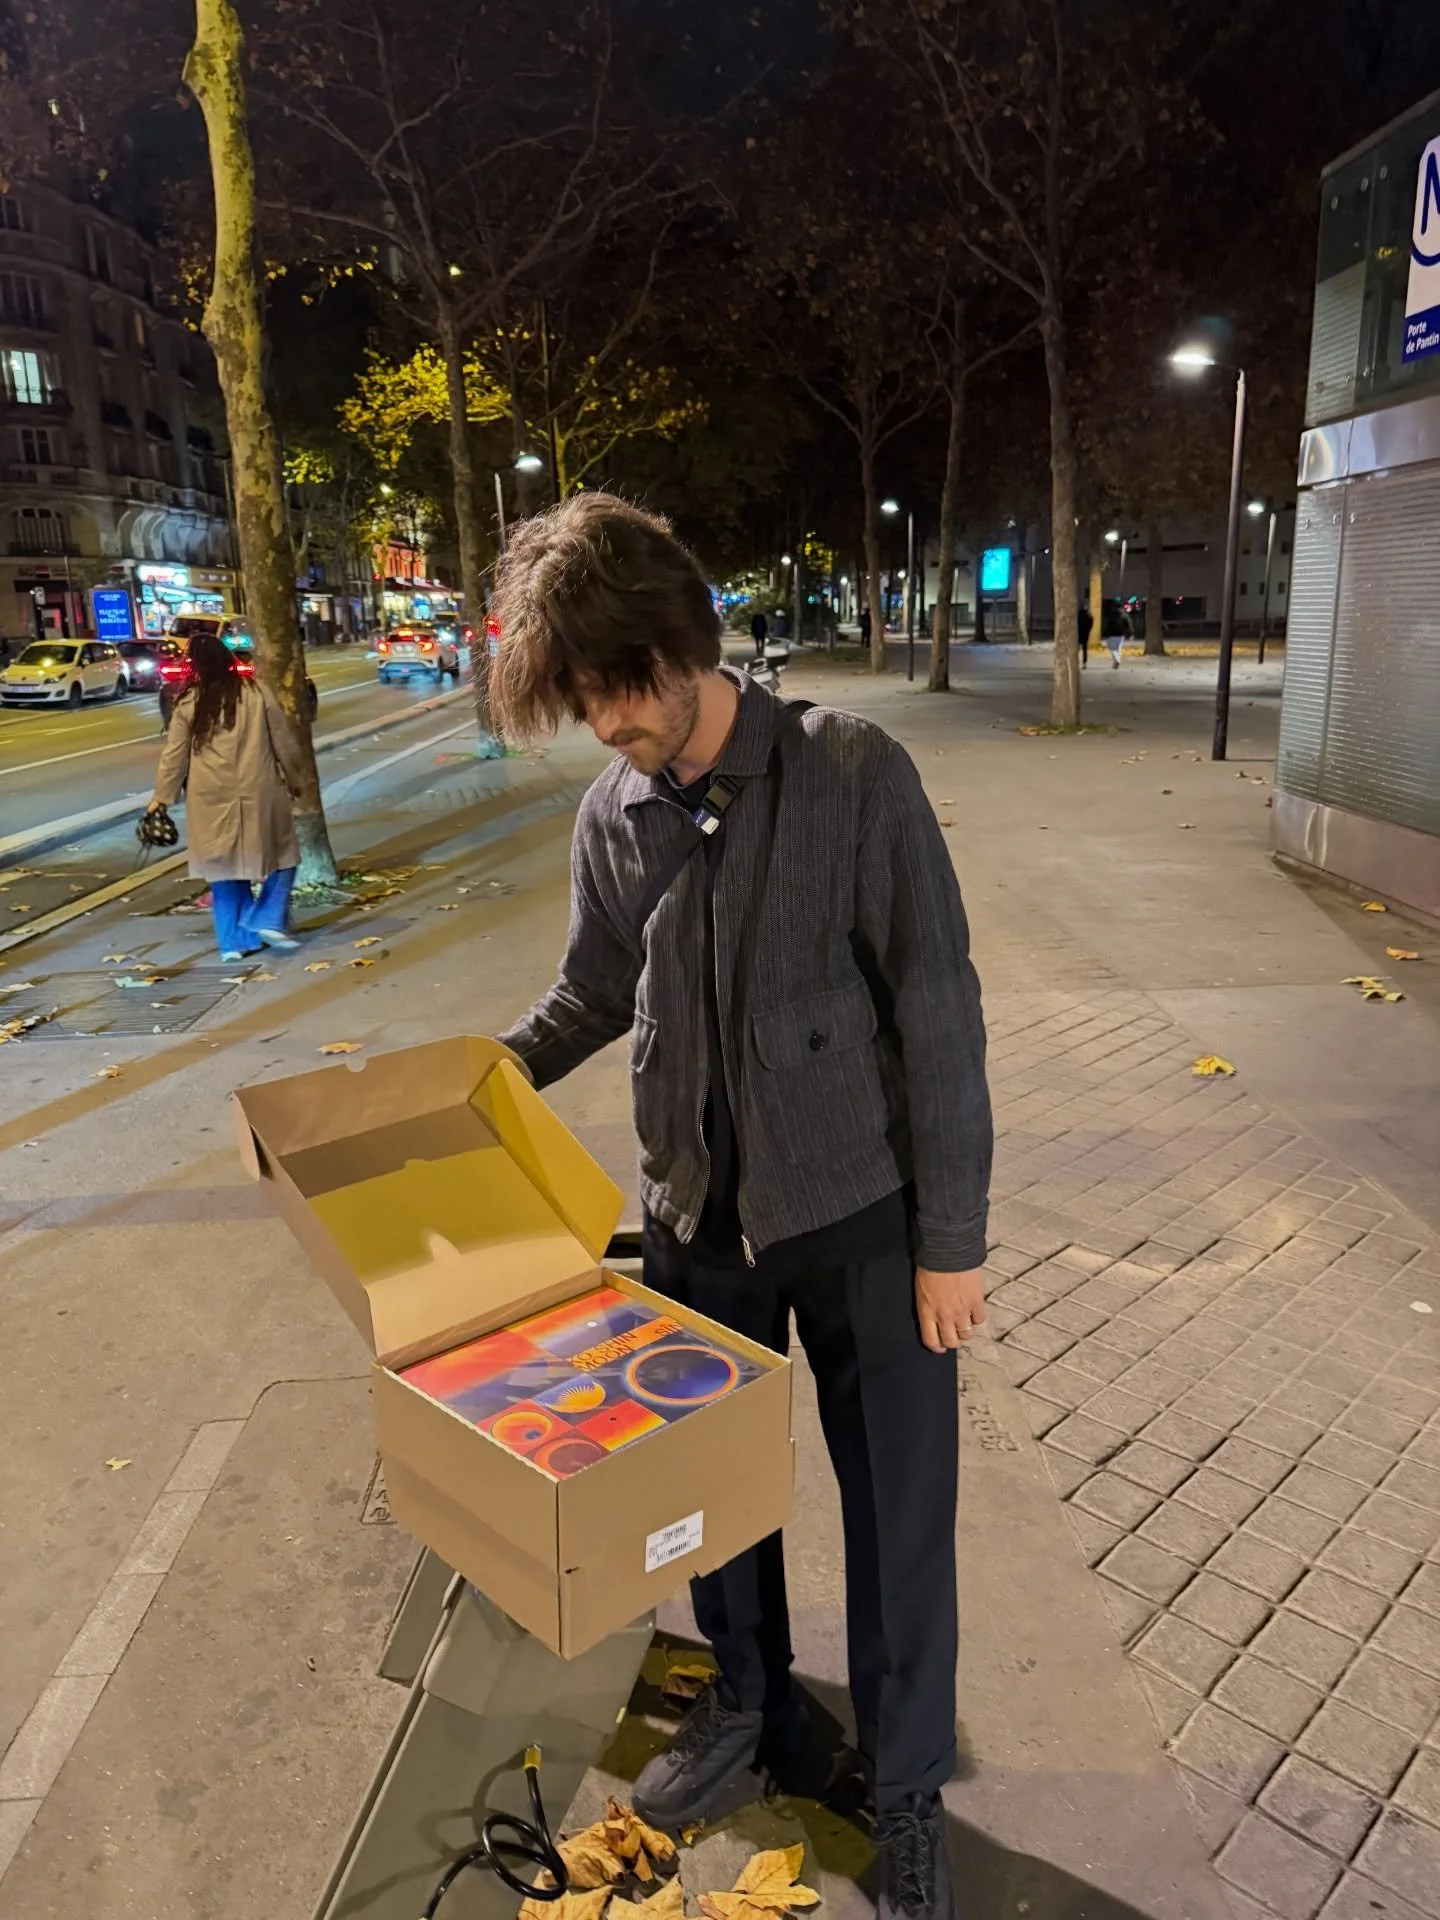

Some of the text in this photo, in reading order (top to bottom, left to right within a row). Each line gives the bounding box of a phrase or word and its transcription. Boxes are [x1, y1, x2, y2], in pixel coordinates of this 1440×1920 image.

[1408, 321, 1427, 338] Porte
[1406, 332, 1439, 354] de Pantin
[594, 1331, 637, 1353] SHIN
[577, 1344, 633, 1371] MOON
